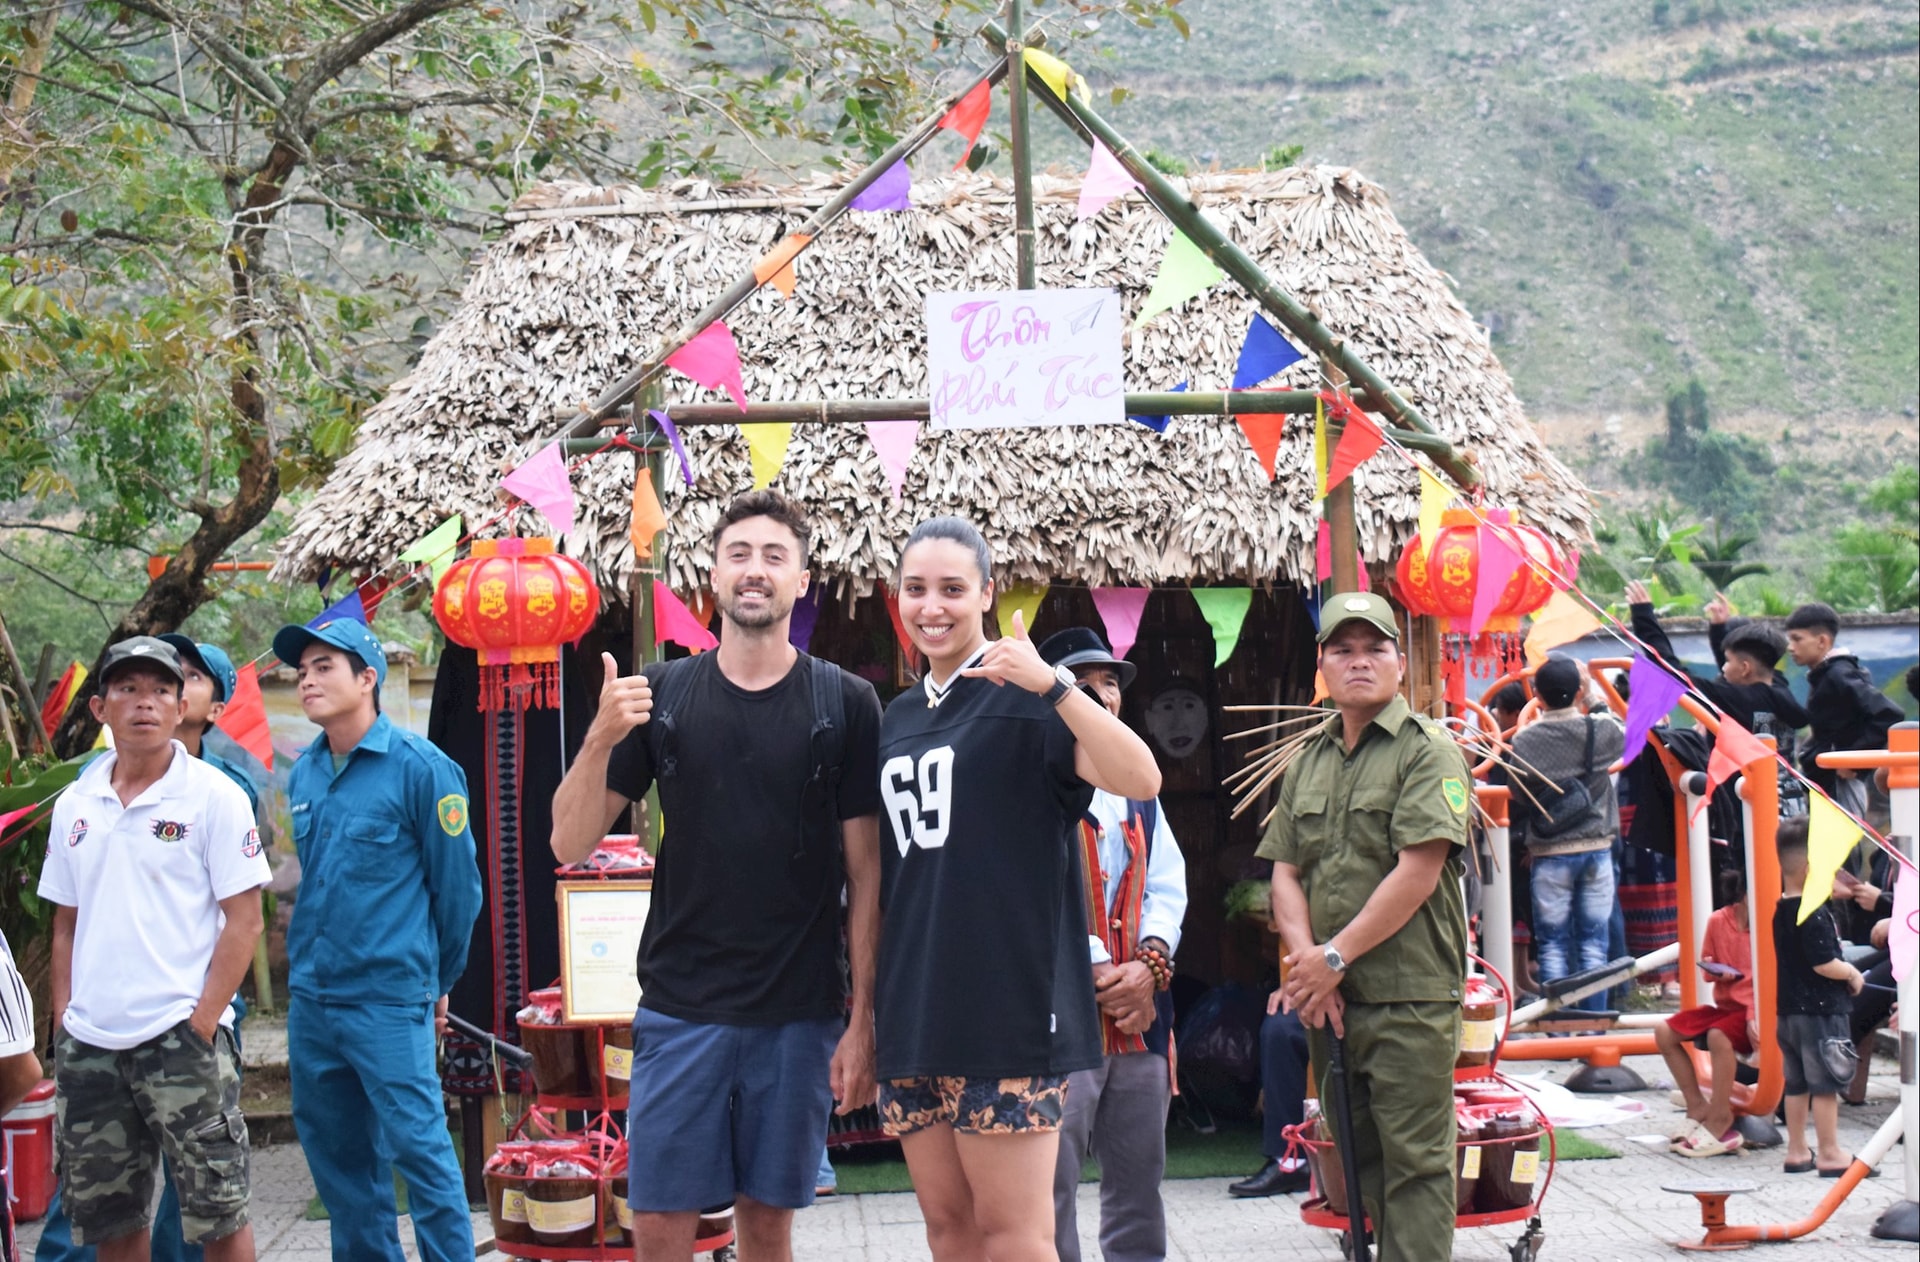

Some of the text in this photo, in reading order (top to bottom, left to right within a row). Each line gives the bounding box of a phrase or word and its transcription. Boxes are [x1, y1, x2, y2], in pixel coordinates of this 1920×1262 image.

[951, 300, 1050, 362] Thôn
[933, 353, 1121, 425] Phú Túc
[880, 745, 955, 858] 69
